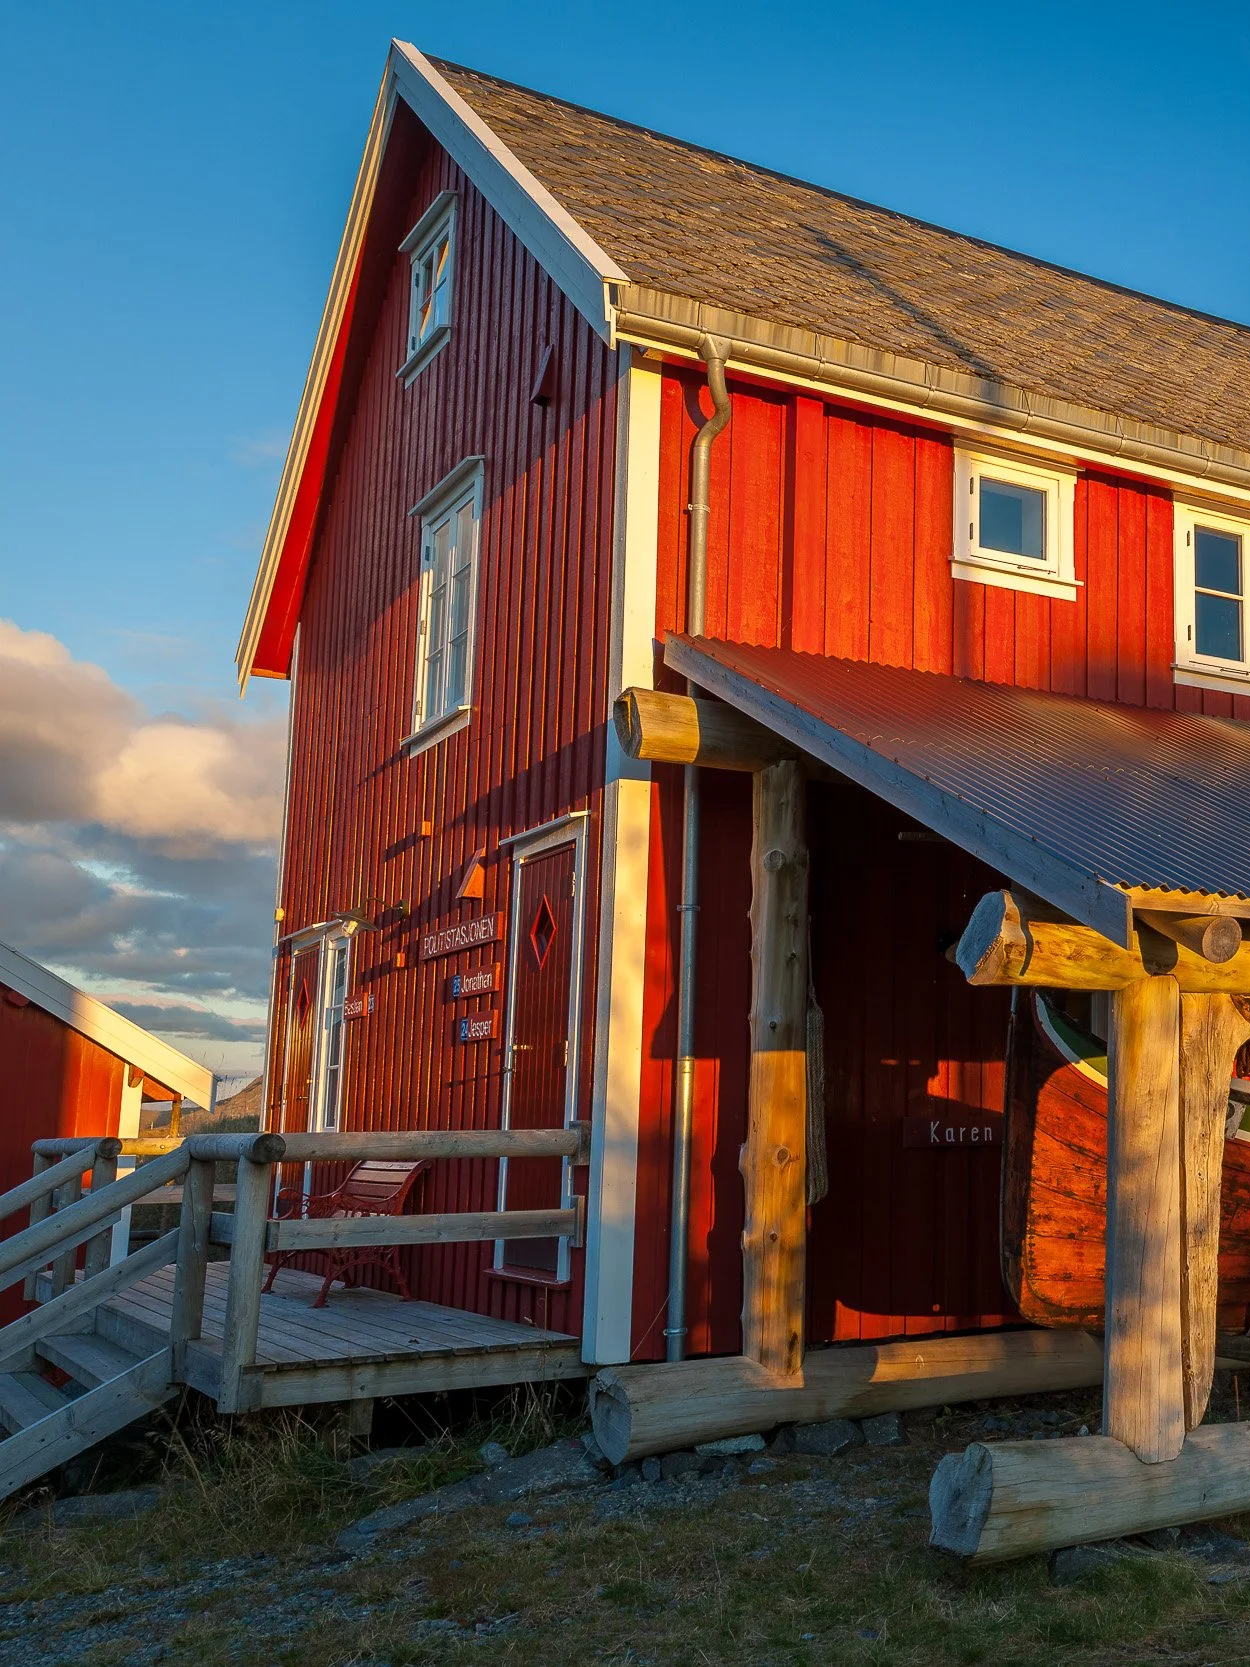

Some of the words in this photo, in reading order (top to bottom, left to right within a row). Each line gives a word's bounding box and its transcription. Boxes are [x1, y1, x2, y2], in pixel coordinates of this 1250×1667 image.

[423, 916, 494, 955] POLITISTASJONEN
[461, 971, 493, 993] Jonathan
[468, 1019, 492, 1039] Jesper
[930, 1121, 993, 1143] Karen
